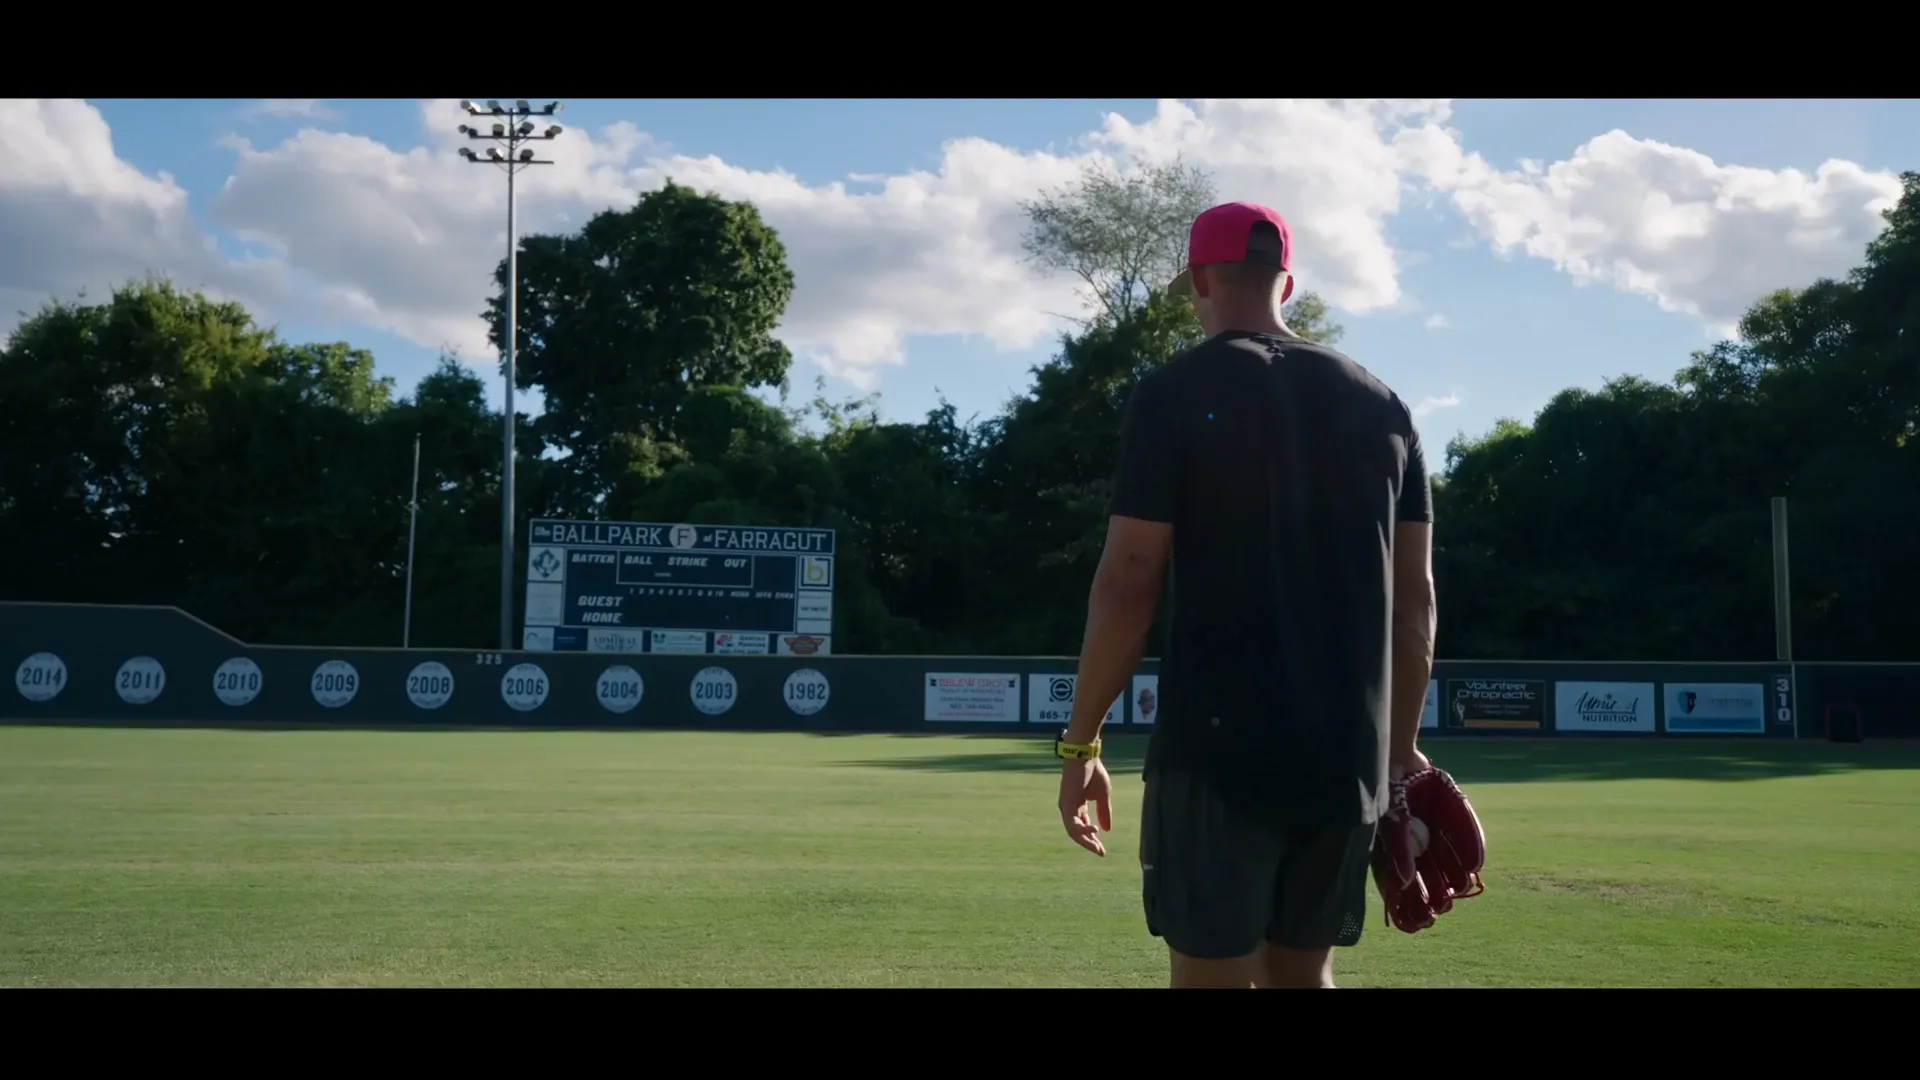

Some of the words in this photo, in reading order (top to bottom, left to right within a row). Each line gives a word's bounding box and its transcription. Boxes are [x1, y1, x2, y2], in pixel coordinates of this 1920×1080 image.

[552, 525, 663, 545] BALLPARK
[678, 528, 691, 547] F
[714, 530, 827, 551] FARRAGUT
[572, 553, 615, 564] BATTER
[624, 556, 653, 565] BALL
[668, 557, 708, 568] STRIKE
[724, 559, 747, 568] OUT
[577, 596, 624, 607] GUEST
[582, 612, 622, 623] HOME
[476, 654, 502, 665] 325
[22, 668, 63, 686] 2014
[121, 672, 160, 689] 2011
[217, 673, 259, 690] 2010
[315, 674, 356, 692] 2009
[411, 676, 450, 694] 2008
[506, 678, 544, 695] 2006
[601, 681, 638, 699] 2004
[695, 682, 733, 700] 2003
[788, 683, 826, 700] 1982
[1456, 689, 1536, 700] Chiropractic
[1465, 681, 1527, 691] Volunteer
[1582, 714, 1637, 723] NUTRITION
